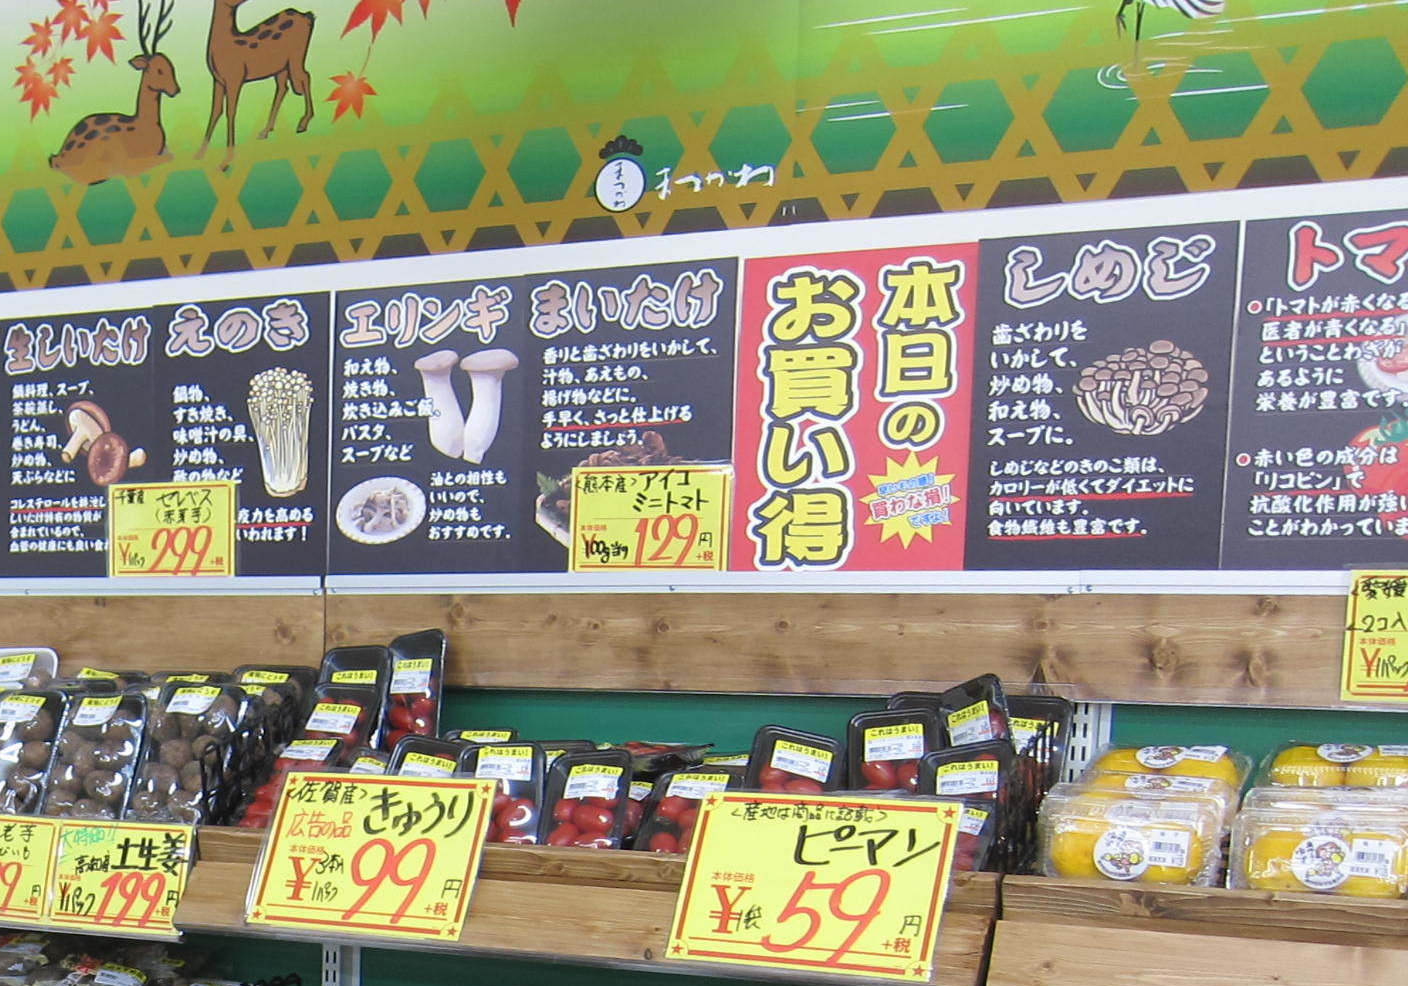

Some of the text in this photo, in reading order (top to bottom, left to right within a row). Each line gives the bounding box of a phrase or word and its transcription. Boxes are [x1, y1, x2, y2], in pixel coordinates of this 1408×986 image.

[1003, 233, 1216, 309] しめじ
[527, 268, 723, 339] まいたけ
[338, 283, 513, 348] エリンギ
[164, 298, 311, 358] えのき
[992, 320, 1089, 346] 歯ざわりを
[1261, 317, 1406, 341] 医者が青くなる」
[3, 315, 152, 376] 生しいたけ
[542, 338, 719, 364] 香りと歯ざわりをいかして、
[871, 256, 966, 452] 本日の
[1258, 338, 1401, 364] ということわざが
[343, 358, 398, 377] 和え物、
[990, 345, 1078, 370] いかして、
[541, 366, 649, 386] 汁物、あえもの、
[989, 372, 1064, 396] 炒め物、
[1256, 367, 1345, 388] あるように
[342, 381, 396, 398] 焼き物、
[541, 387, 637, 406] 揚げ物などに。
[172, 405, 234, 423] すき焼き、
[341, 399, 441, 421] 炊き込みご飯、
[541, 405, 693, 427] 手早く、さっと仕上げる
[746, 264, 868, 572] お買い得
[988, 399, 1062, 422] 和え物、
[172, 424, 255, 445] 味噌汁の具、
[340, 424, 392, 442] パスタ、
[540, 429, 644, 449] ようにしましょう。
[987, 424, 1075, 447] スープに。
[340, 445, 413, 462] スープなど
[1254, 446, 1398, 468] 赤い色の成分は
[989, 456, 1165, 477] しめじなどのきのこ類は、
[429, 470, 507, 487] 油との相性も
[639, 468, 691, 492] アイコ
[988, 475, 1194, 496] カロリーが低くてダイエットに
[155, 489, 214, 508] セレベス
[429, 488, 485, 503] いいので、
[632, 488, 709, 514] ミニトマト
[428, 506, 482, 523] 炒め物も
[988, 499, 1089, 517] 向いています。
[427, 523, 512, 540] おすすめです。
[987, 517, 1150, 537] 食物繊維も豊富です。
[147, 525, 213, 576] 299
[634, 513, 699, 567] 129
[698, 531, 713, 548] 円
[286, 808, 354, 839] 広告の品
[362, 787, 475, 838] きゅうり
[792, 823, 941, 868] ピーマン
[341, 837, 437, 924] 99
[711, 869, 755, 884] 本体価格
[93, 870, 166, 928] 199
[441, 878, 462, 900] 円
[709, 883, 751, 936] ¥
[761, 867, 891, 966] 59
[898, 914, 923, 938] 円
[881, 935, 912, 954] +税
